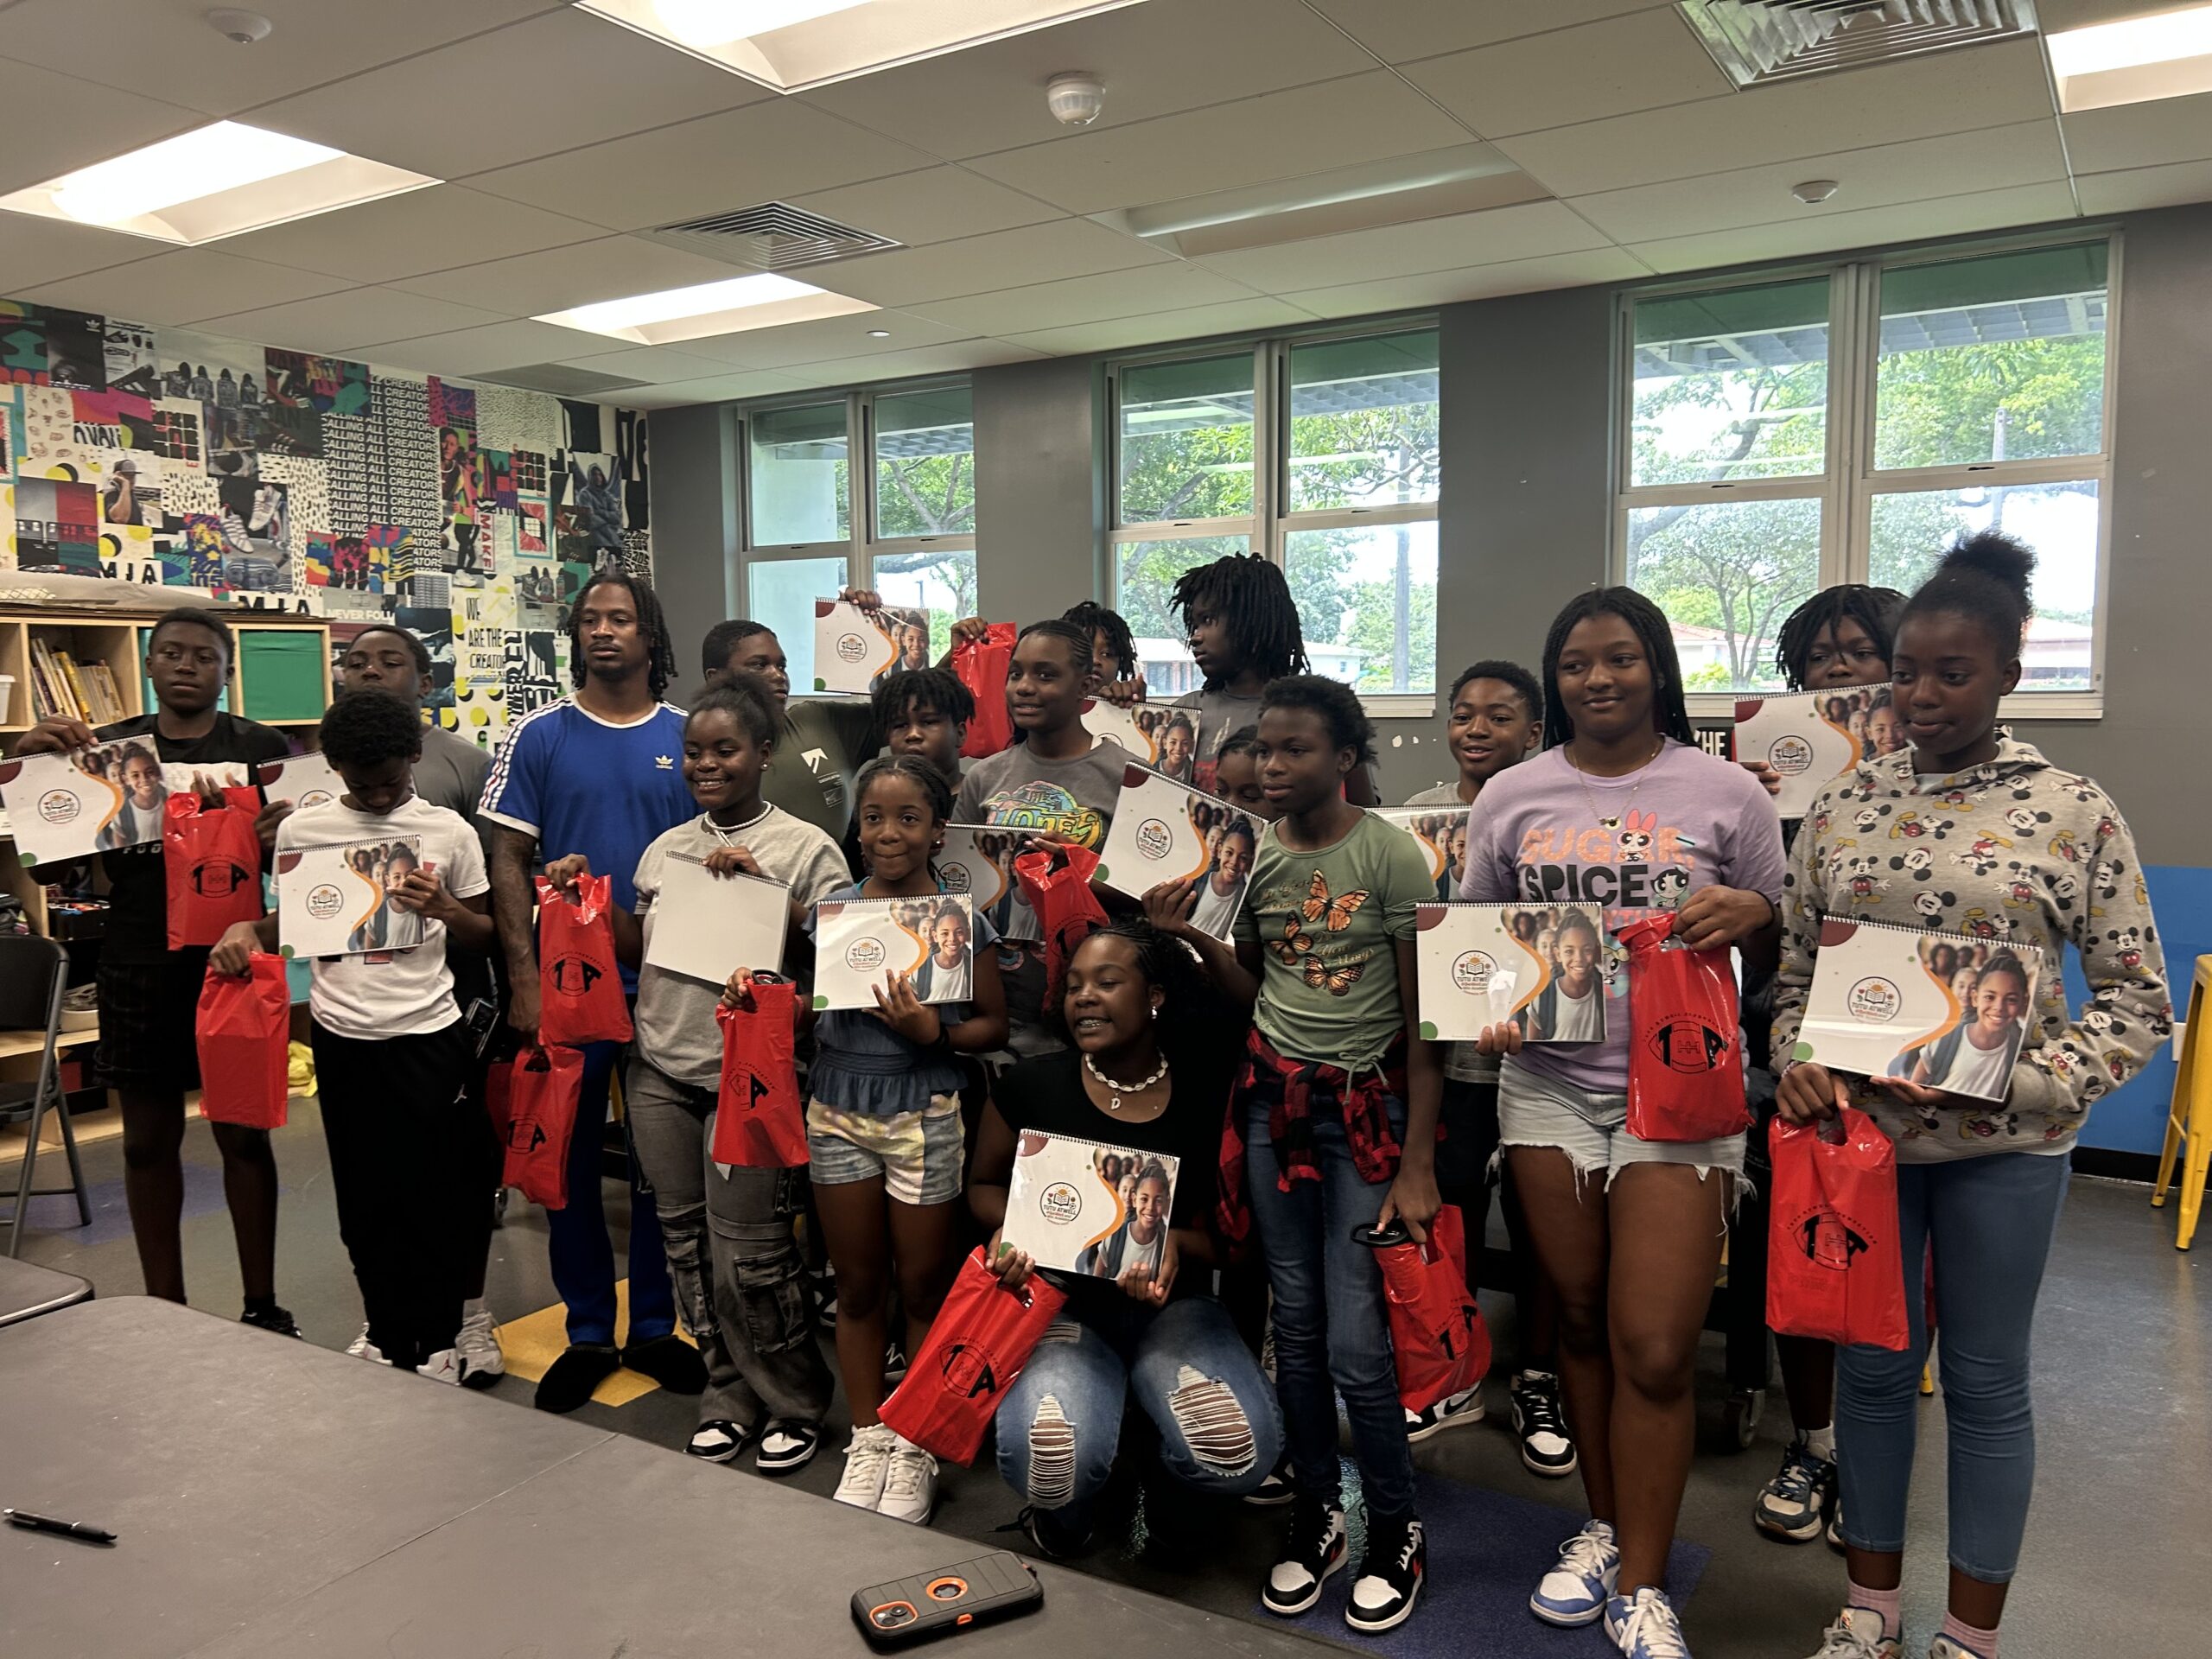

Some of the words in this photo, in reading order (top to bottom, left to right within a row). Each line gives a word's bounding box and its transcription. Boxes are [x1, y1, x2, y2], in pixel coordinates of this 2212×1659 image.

[365, 424, 384, 435] ALL
[366, 435, 385, 445] ALL
[366, 445, 385, 454] ALL
[367, 454, 385, 465] ALL
[368, 465, 386, 474] ALL
[368, 475, 386, 485] ALL
[369, 486, 387, 494] ALL
[369, 495, 388, 505] ALL
[370, 505, 388, 514] ALL
[370, 516, 389, 524] ALL
[468, 628, 485, 647] ARE
[486, 628, 503, 647] THE
[1524, 864, 1648, 907] SPICE
